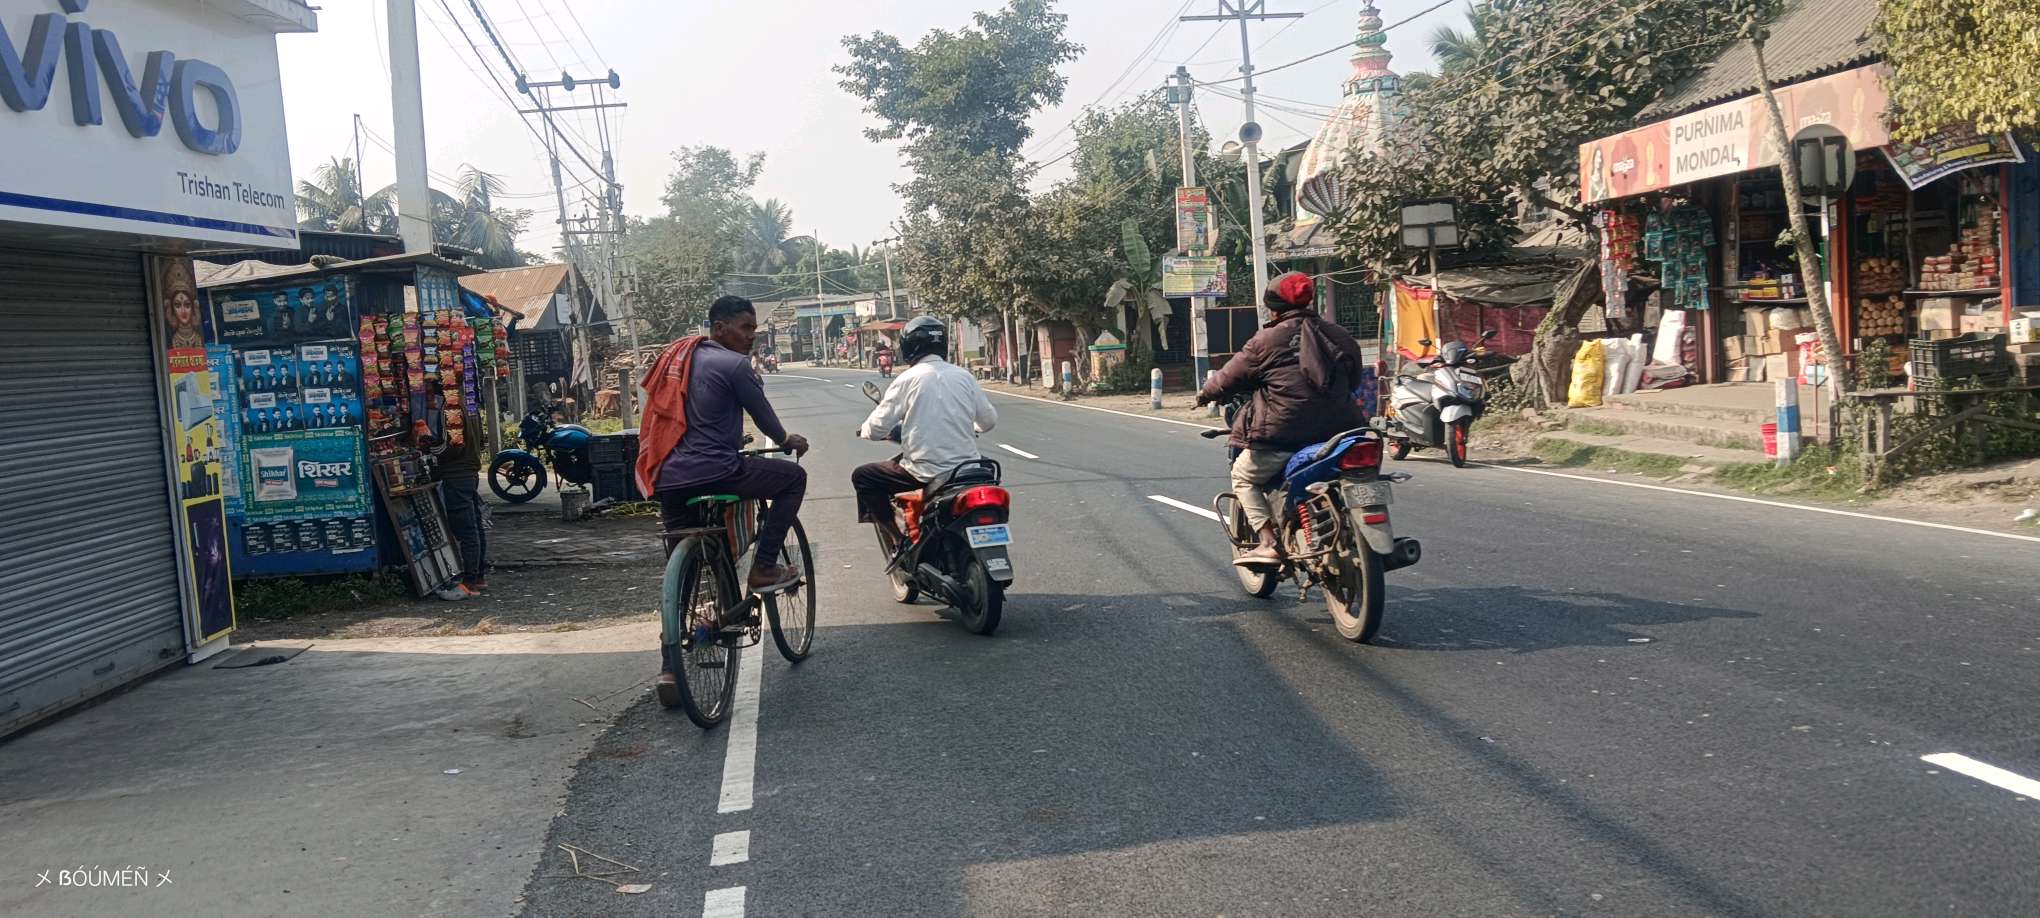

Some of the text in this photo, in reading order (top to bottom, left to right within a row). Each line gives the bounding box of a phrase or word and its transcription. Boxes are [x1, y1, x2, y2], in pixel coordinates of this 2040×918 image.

[0, 0, 242, 155] vivo
[1675, 110, 1744, 145] PURNIMA
[1676, 148, 1738, 174] MONDAL
[177, 171, 285, 209] Trishan Telecom
[297, 459, 352, 479] शिखर
